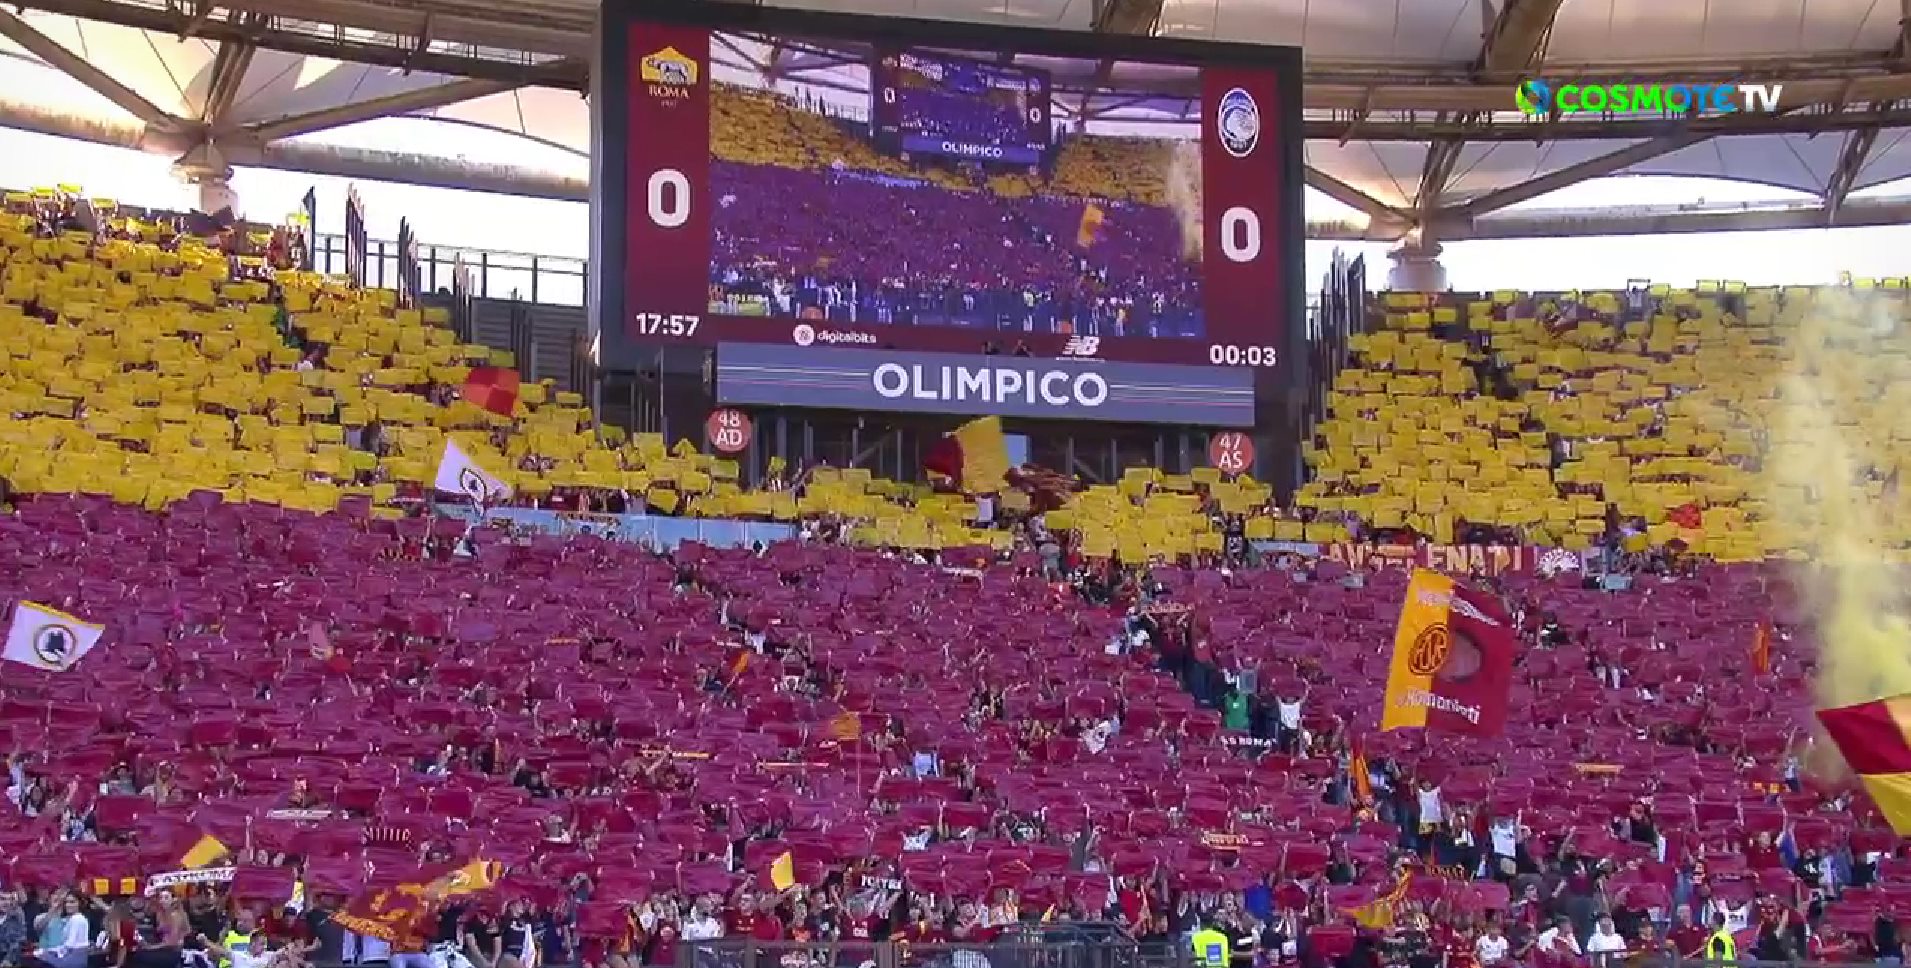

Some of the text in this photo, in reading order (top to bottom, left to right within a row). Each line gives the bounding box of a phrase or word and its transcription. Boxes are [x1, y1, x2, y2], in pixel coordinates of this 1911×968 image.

[648, 84, 690, 100] ROMA
[942, 141, 1003, 157] OLIMPICO
[648, 169, 691, 227] 0
[1212, 206, 1251, 262] 0
[636, 313, 700, 337] 17:57
[1210, 344, 1277, 367] 00:03
[873, 362, 1108, 407] OLIMPICO
[717, 410, 742, 428] 48
[715, 427, 744, 447] AD
[1218, 433, 1242, 451] 47
[1217, 452, 1244, 470] AS
